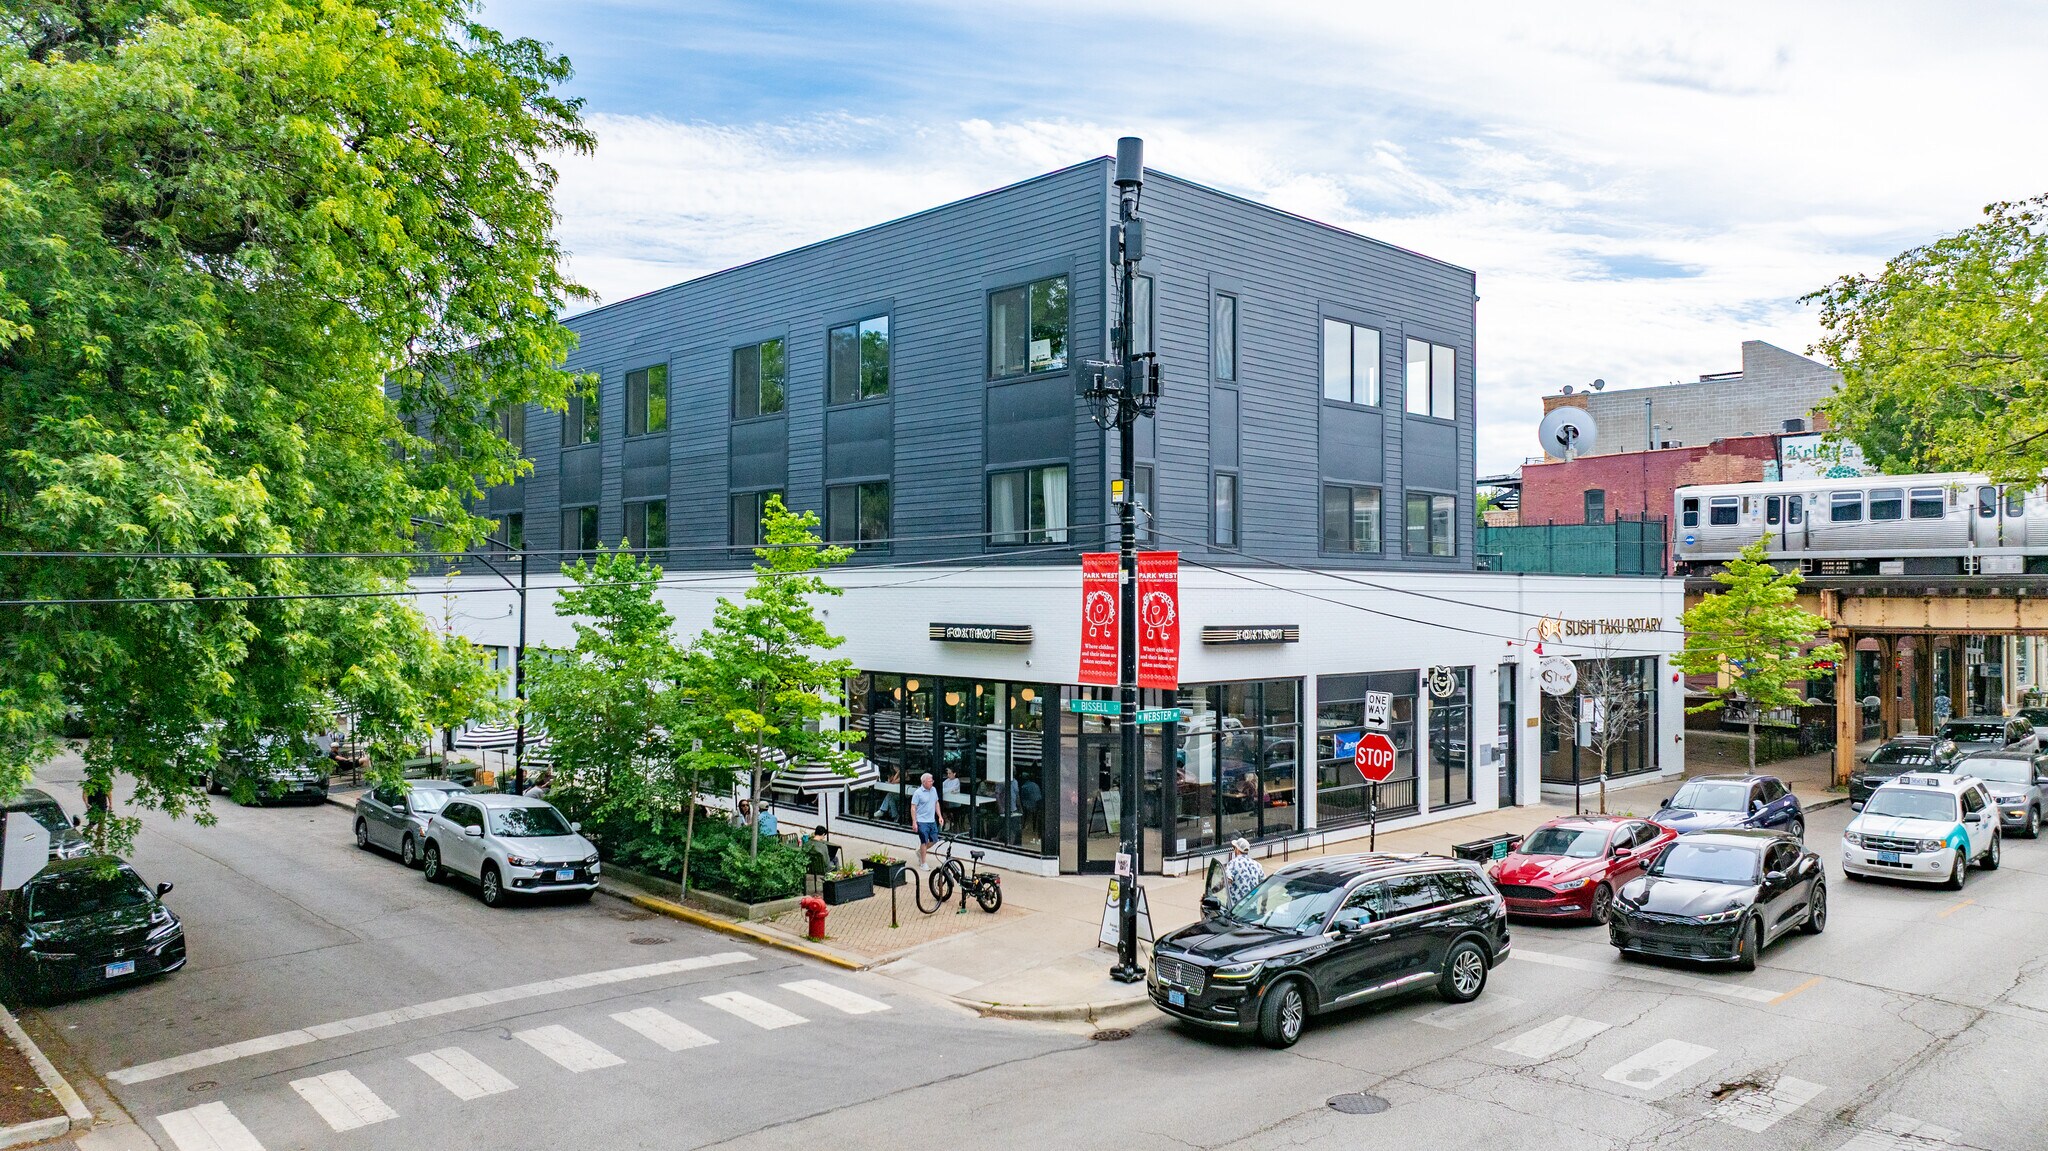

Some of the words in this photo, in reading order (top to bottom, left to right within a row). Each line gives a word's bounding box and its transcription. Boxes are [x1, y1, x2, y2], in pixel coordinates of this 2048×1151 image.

[1566, 620, 1596, 636] SUSHI
[1599, 619, 1624, 634] TAKU
[1627, 618, 1662, 633] ROTARY
[946, 627, 997, 639] FOXTROT
[1237, 629, 1283, 640] FOXTROT
[1560, 659, 1570, 670] TAKU
[1369, 695, 1386, 705] ONE
[1081, 702, 1108, 712] BISSELL
[1368, 705, 1386, 715] WAY
[1143, 711, 1171, 721] WEBSTER
[1357, 747, 1392, 768] STOP
